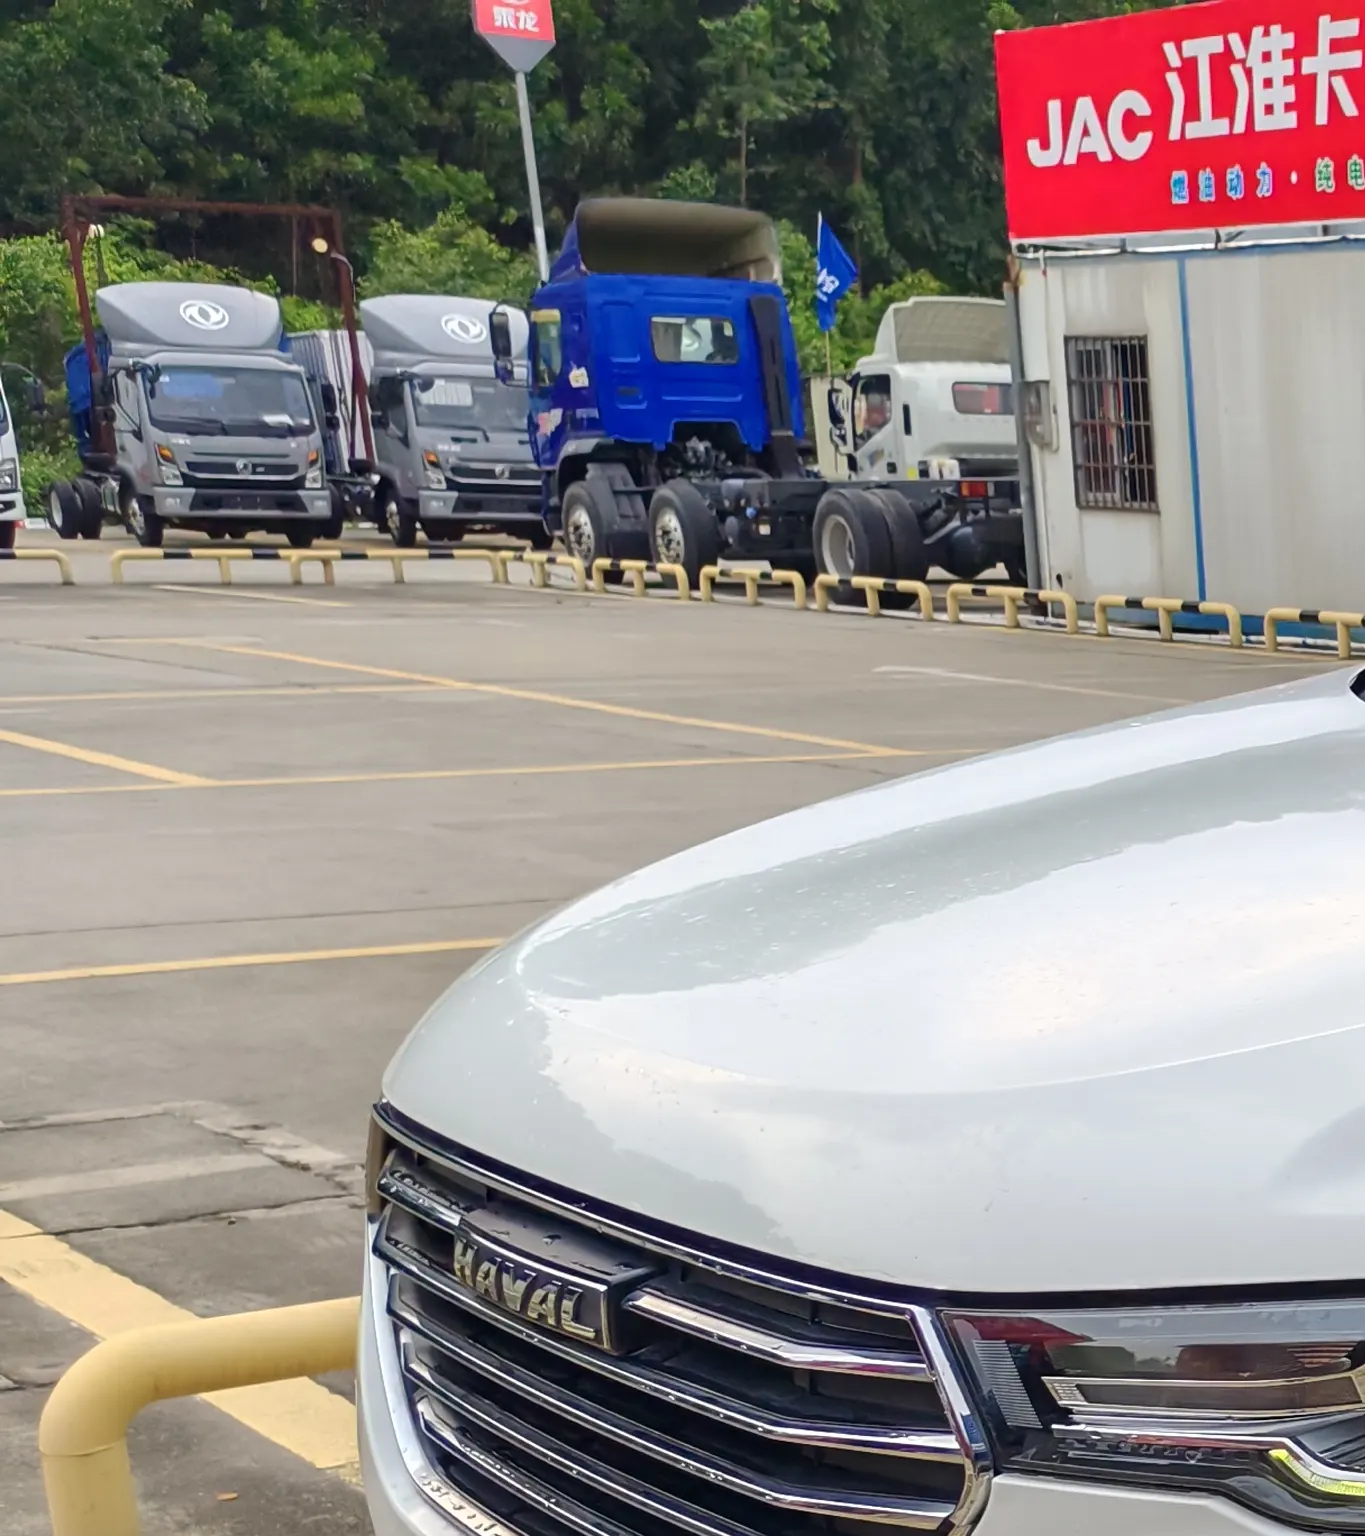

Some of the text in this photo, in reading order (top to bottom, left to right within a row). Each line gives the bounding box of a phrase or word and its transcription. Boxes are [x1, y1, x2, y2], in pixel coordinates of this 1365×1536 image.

[493, 5, 540, 33] 乘龙
[1026, 89, 1153, 168] JAC
[454, 1234, 597, 1340] HAVAL
